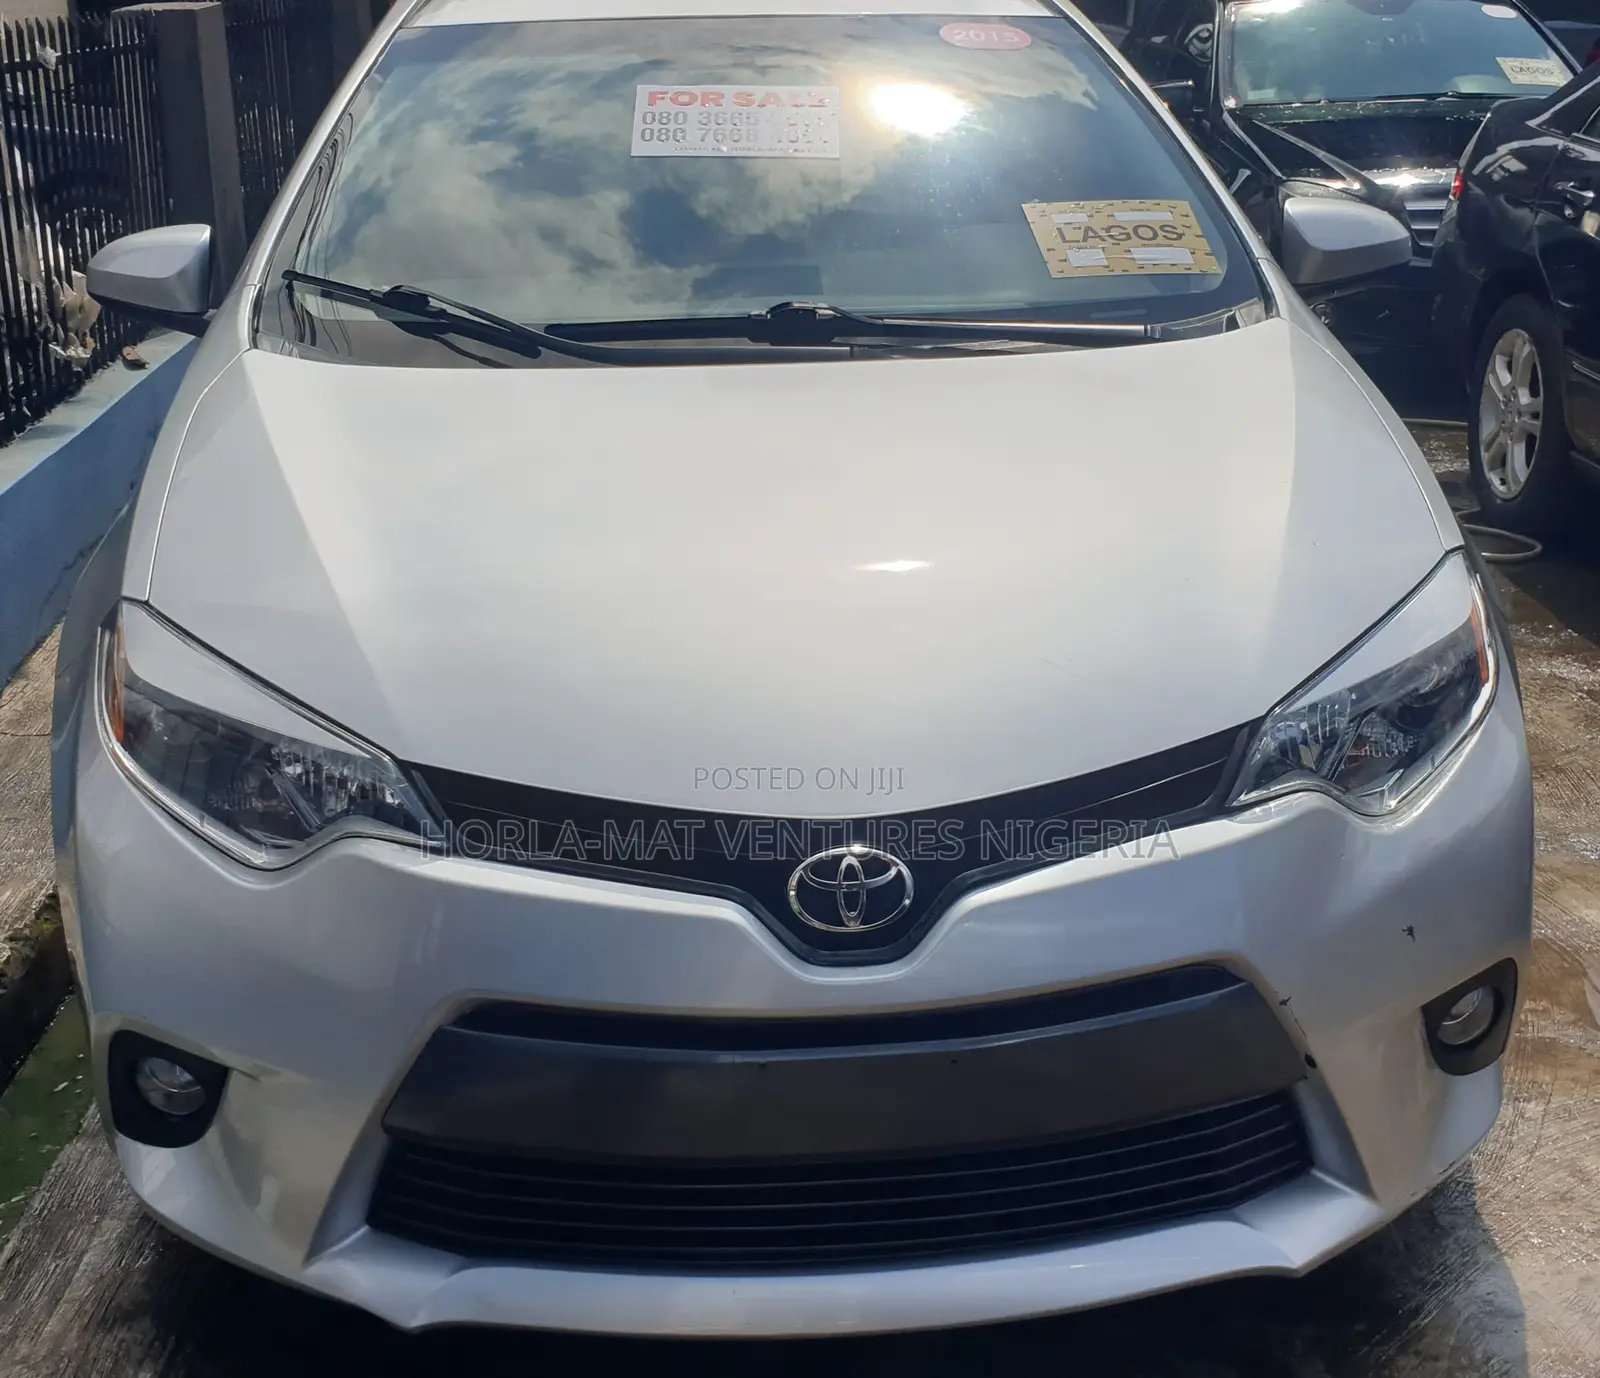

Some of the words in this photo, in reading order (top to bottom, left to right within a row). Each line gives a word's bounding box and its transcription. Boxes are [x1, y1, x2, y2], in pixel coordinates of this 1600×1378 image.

[647, 91, 726, 107] FOR
[641, 111, 688, 126] 080
[1056, 224, 1185, 244] LAGOS
